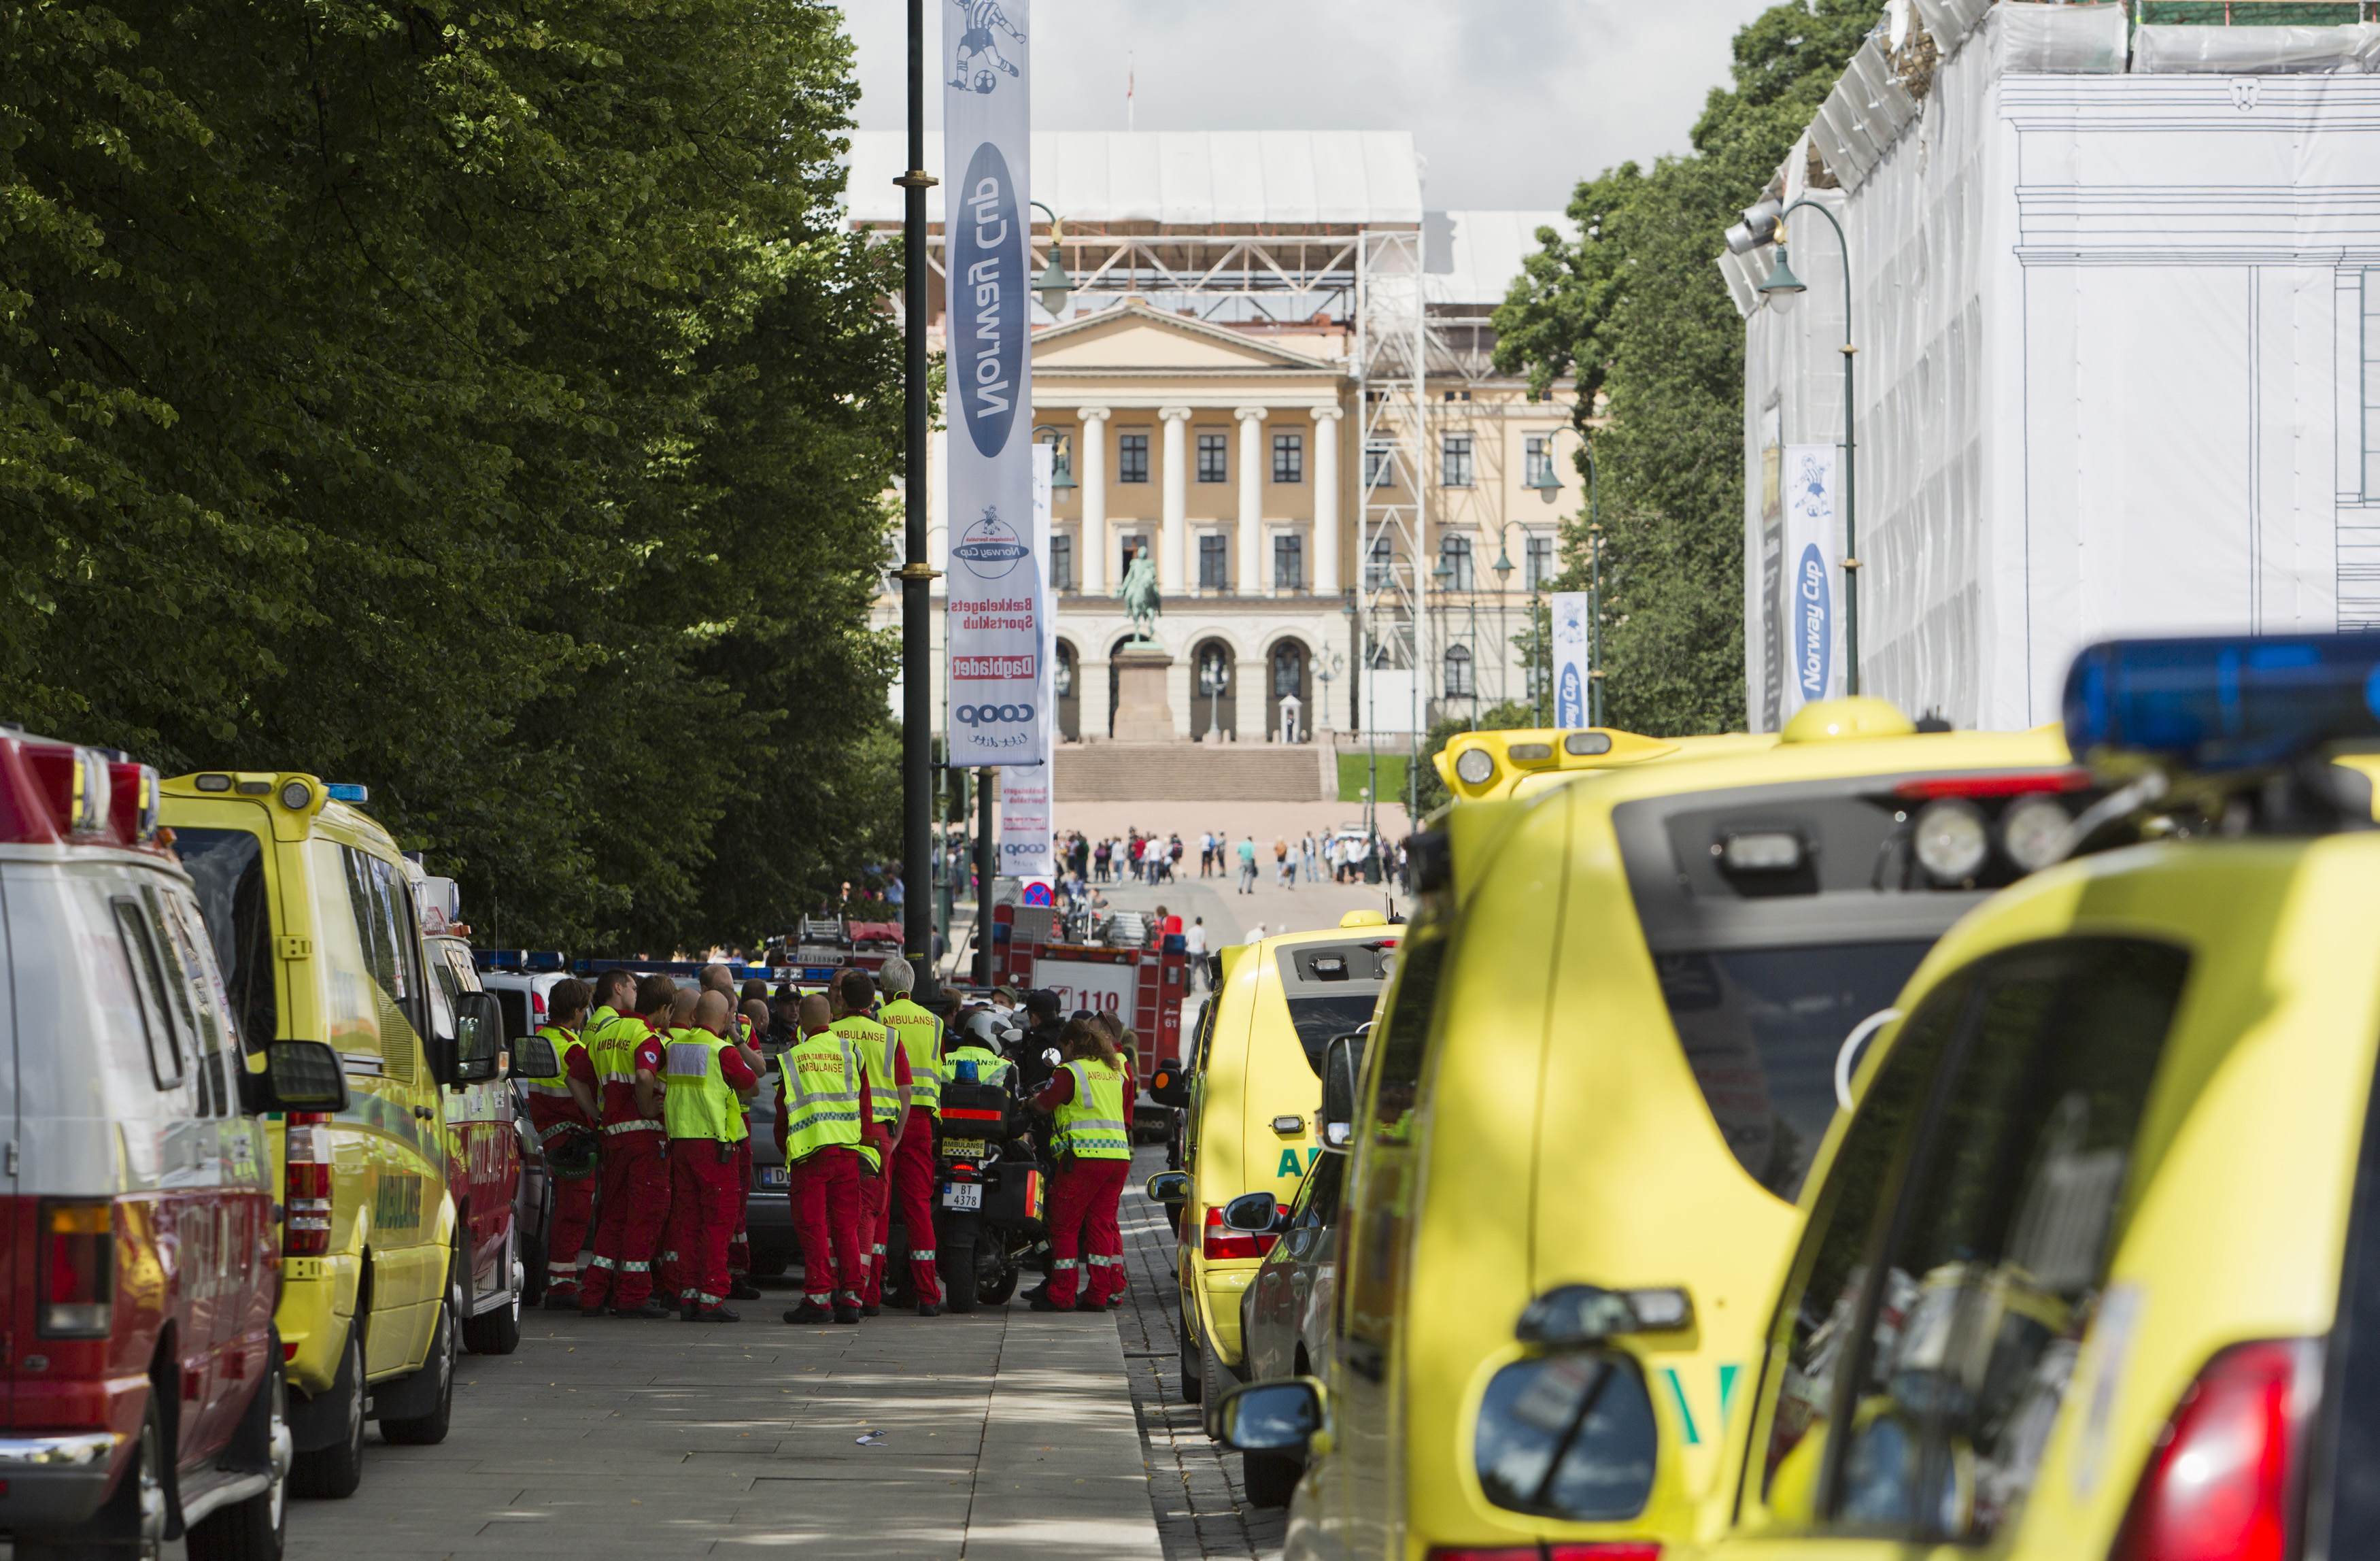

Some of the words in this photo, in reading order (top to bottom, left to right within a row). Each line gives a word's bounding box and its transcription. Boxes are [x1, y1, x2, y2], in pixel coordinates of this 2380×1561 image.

[1802, 560, 1824, 601] Cup
[1803, 604, 1824, 692] Norway
[1077, 989, 1119, 1012] 110
[883, 1014, 935, 1027] AMBULANSE
[835, 1029, 885, 1043] MBULANSE
[798, 1062, 843, 1075] AMBULANSE
[1088, 1071, 1121, 1081] AMBULANS
[943, 1141, 985, 1149] AMBULANSE
[961, 1185, 972, 1195] BT
[954, 1195, 976, 1207] 4378
